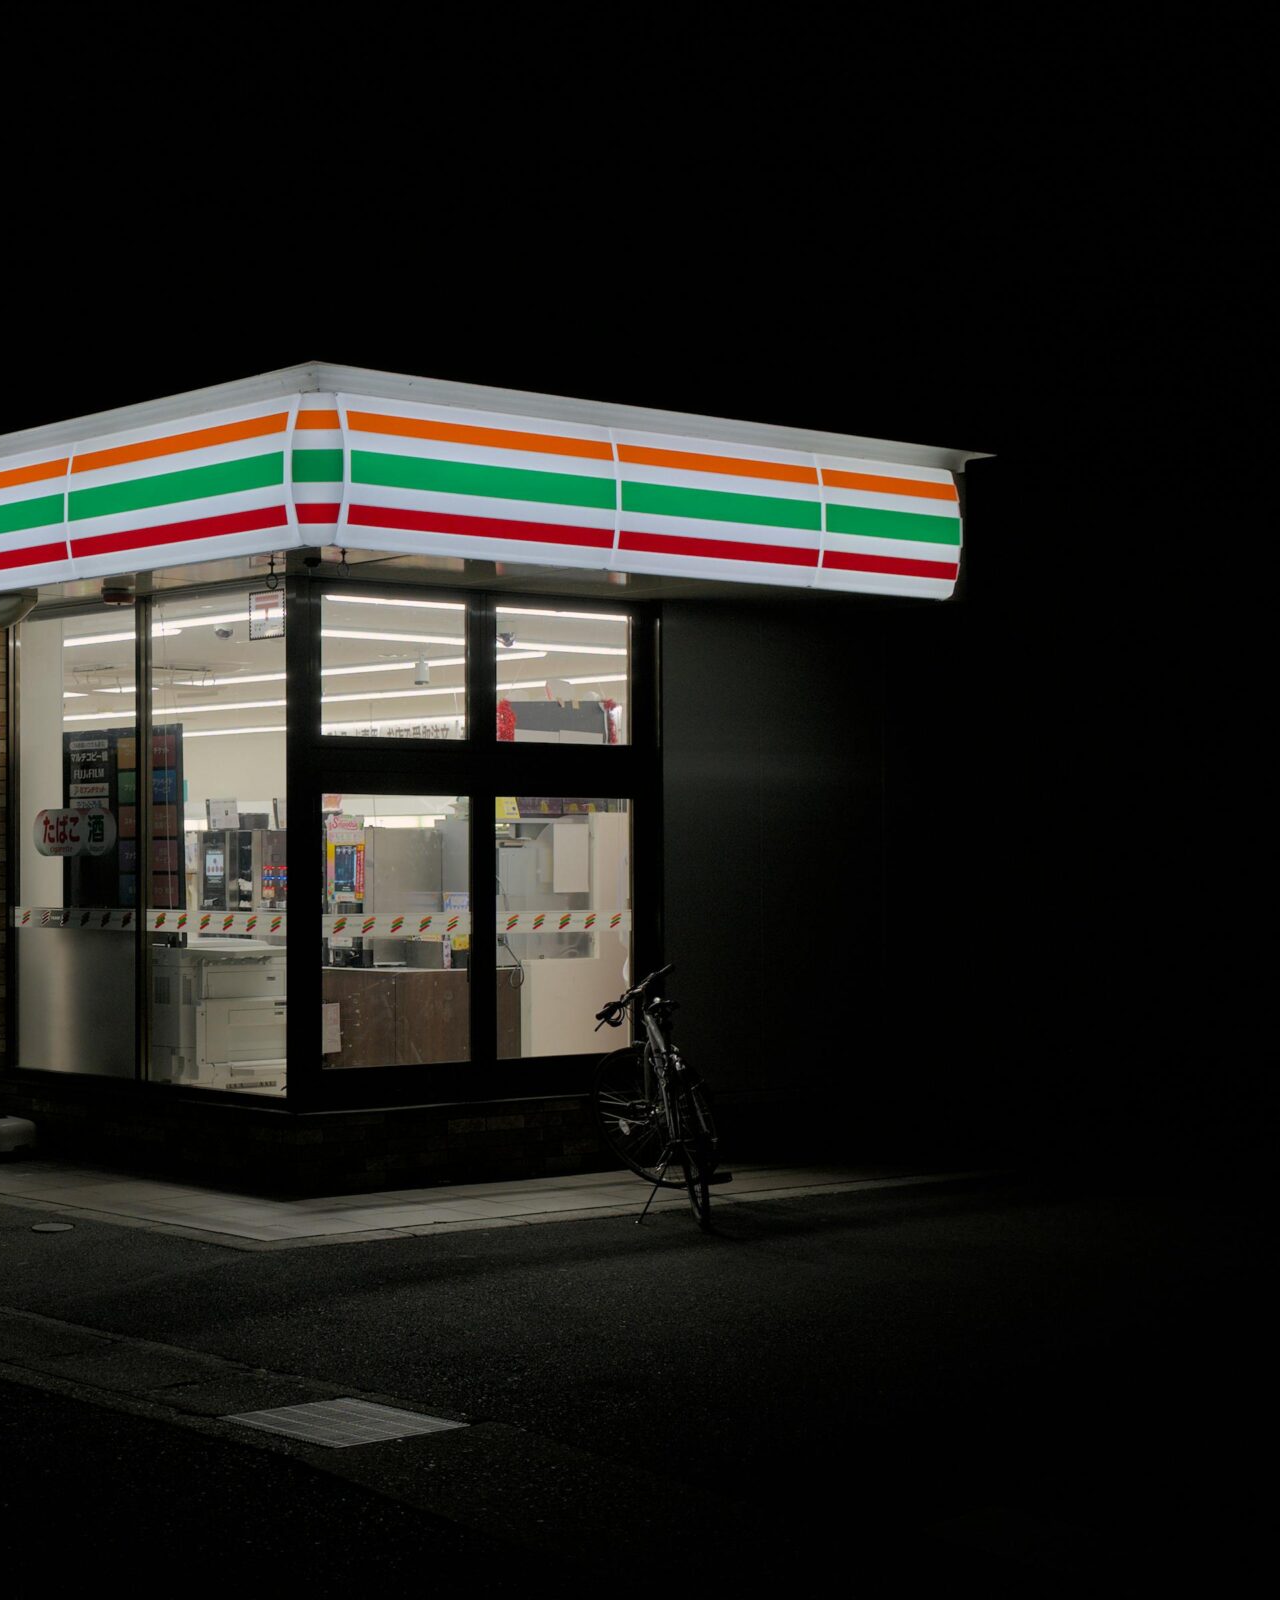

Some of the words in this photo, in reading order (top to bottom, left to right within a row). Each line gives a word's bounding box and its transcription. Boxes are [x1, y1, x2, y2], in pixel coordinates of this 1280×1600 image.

[43, 815, 80, 843] たばこ
[87, 814, 105, 843] 酒
